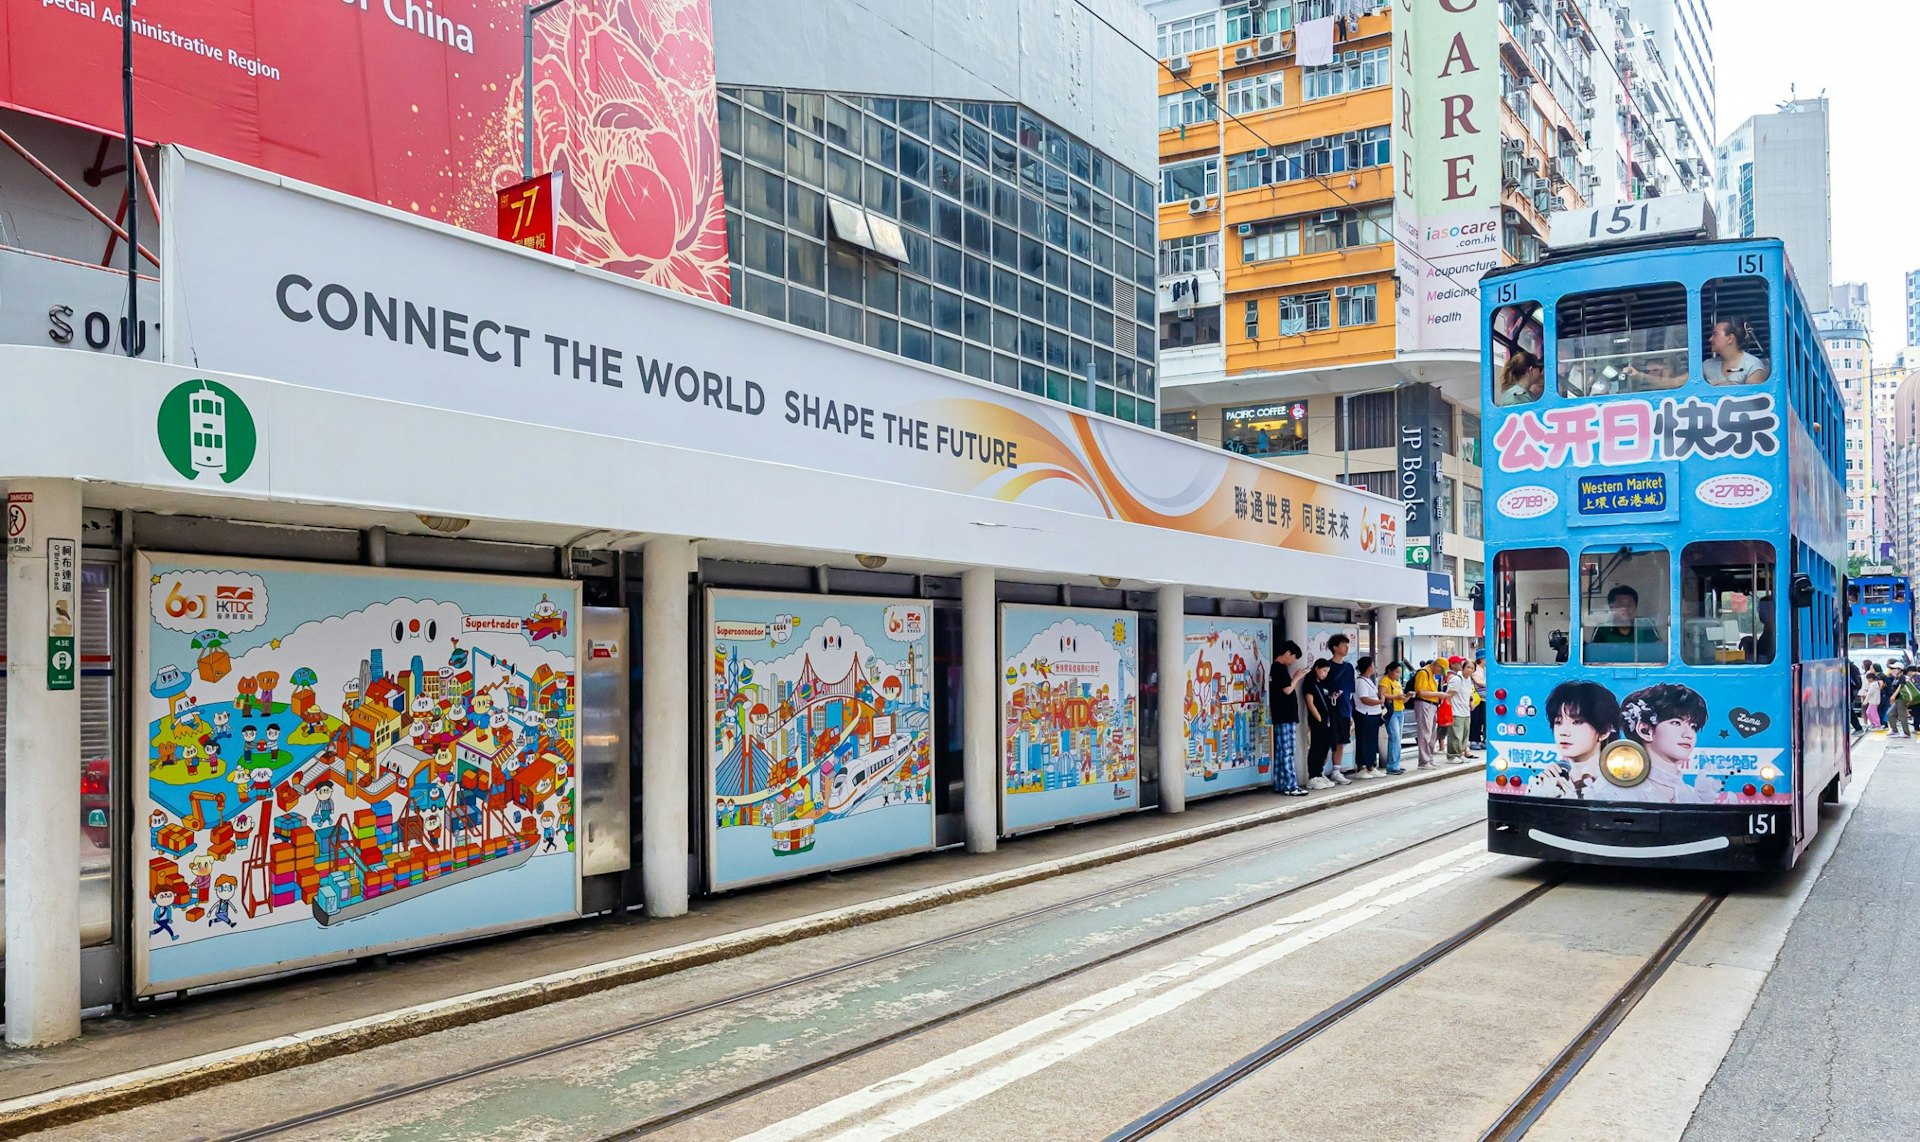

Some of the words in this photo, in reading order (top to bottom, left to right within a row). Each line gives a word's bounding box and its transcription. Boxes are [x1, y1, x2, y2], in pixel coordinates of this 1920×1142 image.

[383, 0, 475, 54] China
[43, 0, 96, 19] pecial
[101, 7, 223, 62] Administrative
[227, 49, 281, 81] Region
[1399, 0, 1414, 200] ARE
[1426, 220, 1497, 241] iasocare
[1590, 204, 1649, 238] 151
[1455, 234, 1497, 248] .com.hk
[1426, 260, 1497, 278] Acupuncture
[1738, 254, 1764, 274] 151
[1426, 287, 1478, 301] Medicine
[1497, 283, 1517, 303] 151
[1427, 311, 1462, 325] Health
[49, 303, 160, 358] SOU
[276, 274, 530, 368] CONNECT
[544, 333, 623, 389] THE
[636, 355, 765, 416] WORLD
[784, 390, 874, 440] SHAPE
[882, 412, 928, 451] THE
[937, 425, 1018, 469] FUTURE
[1226, 409, 1256, 420] PACIFIC
[1256, 405, 1287, 417] COFFEE
[1402, 425, 1422, 449] JP
[1497, 396, 1778, 471] 公开日快乐
[1402, 456, 1425, 521] Books
[1581, 481, 1625, 495] Western
[1626, 476, 1663, 491] Market
[1234, 485, 1292, 529] 聯通世界
[1303, 503, 1350, 541] 同塑未來
[216, 600, 254, 614] HKTDC
[465, 617, 520, 631] Supertrader
[716, 625, 765, 637] Superconnector
[1748, 813, 1776, 835] 151
